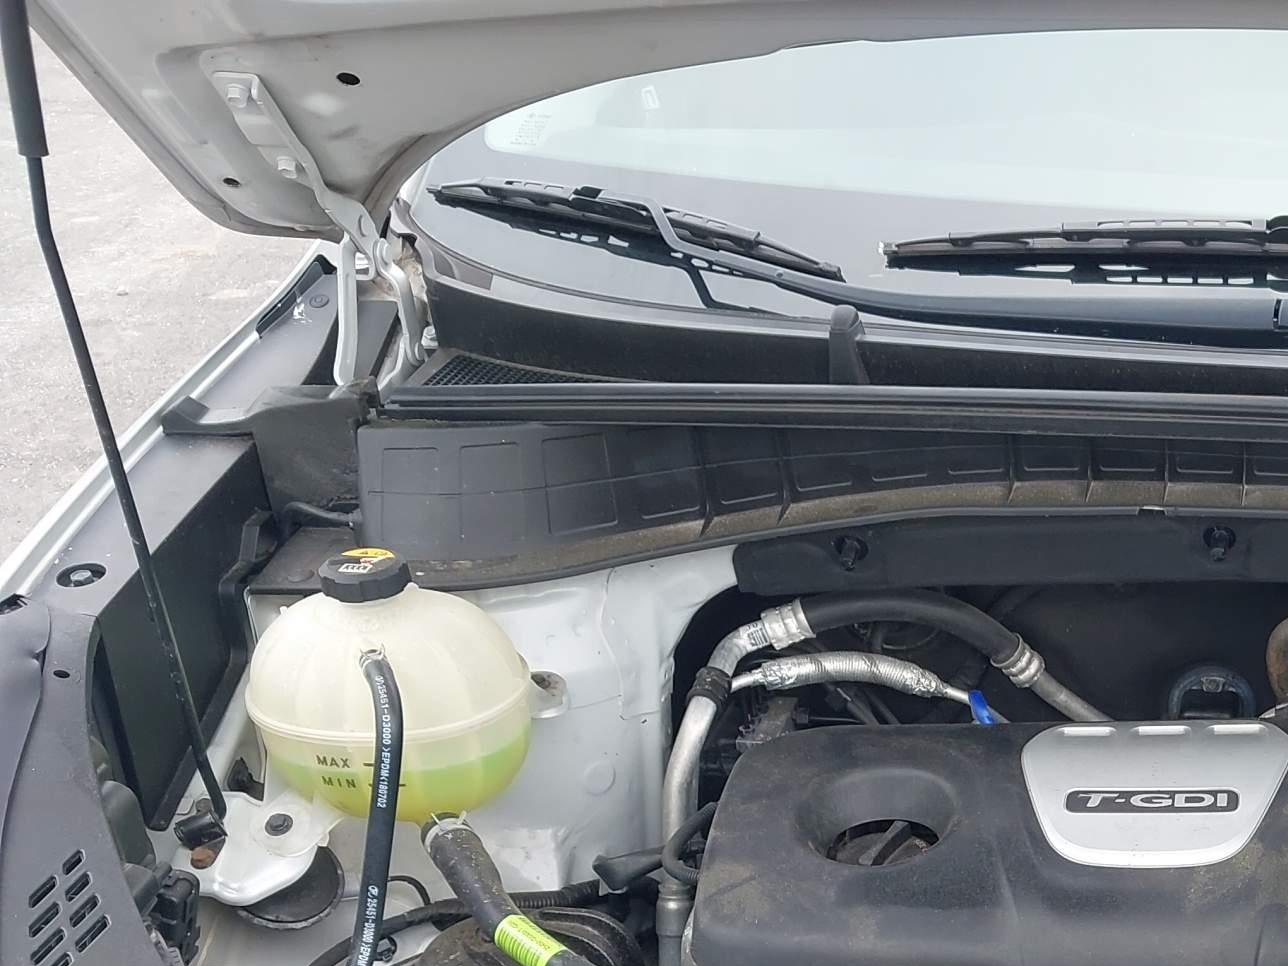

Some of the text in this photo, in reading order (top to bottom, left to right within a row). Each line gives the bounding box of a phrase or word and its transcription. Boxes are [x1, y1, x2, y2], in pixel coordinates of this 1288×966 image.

[316, 754, 350, 768] MAX
[321, 775, 357, 789] MIN
[1077, 792, 1229, 808] T-GDI
